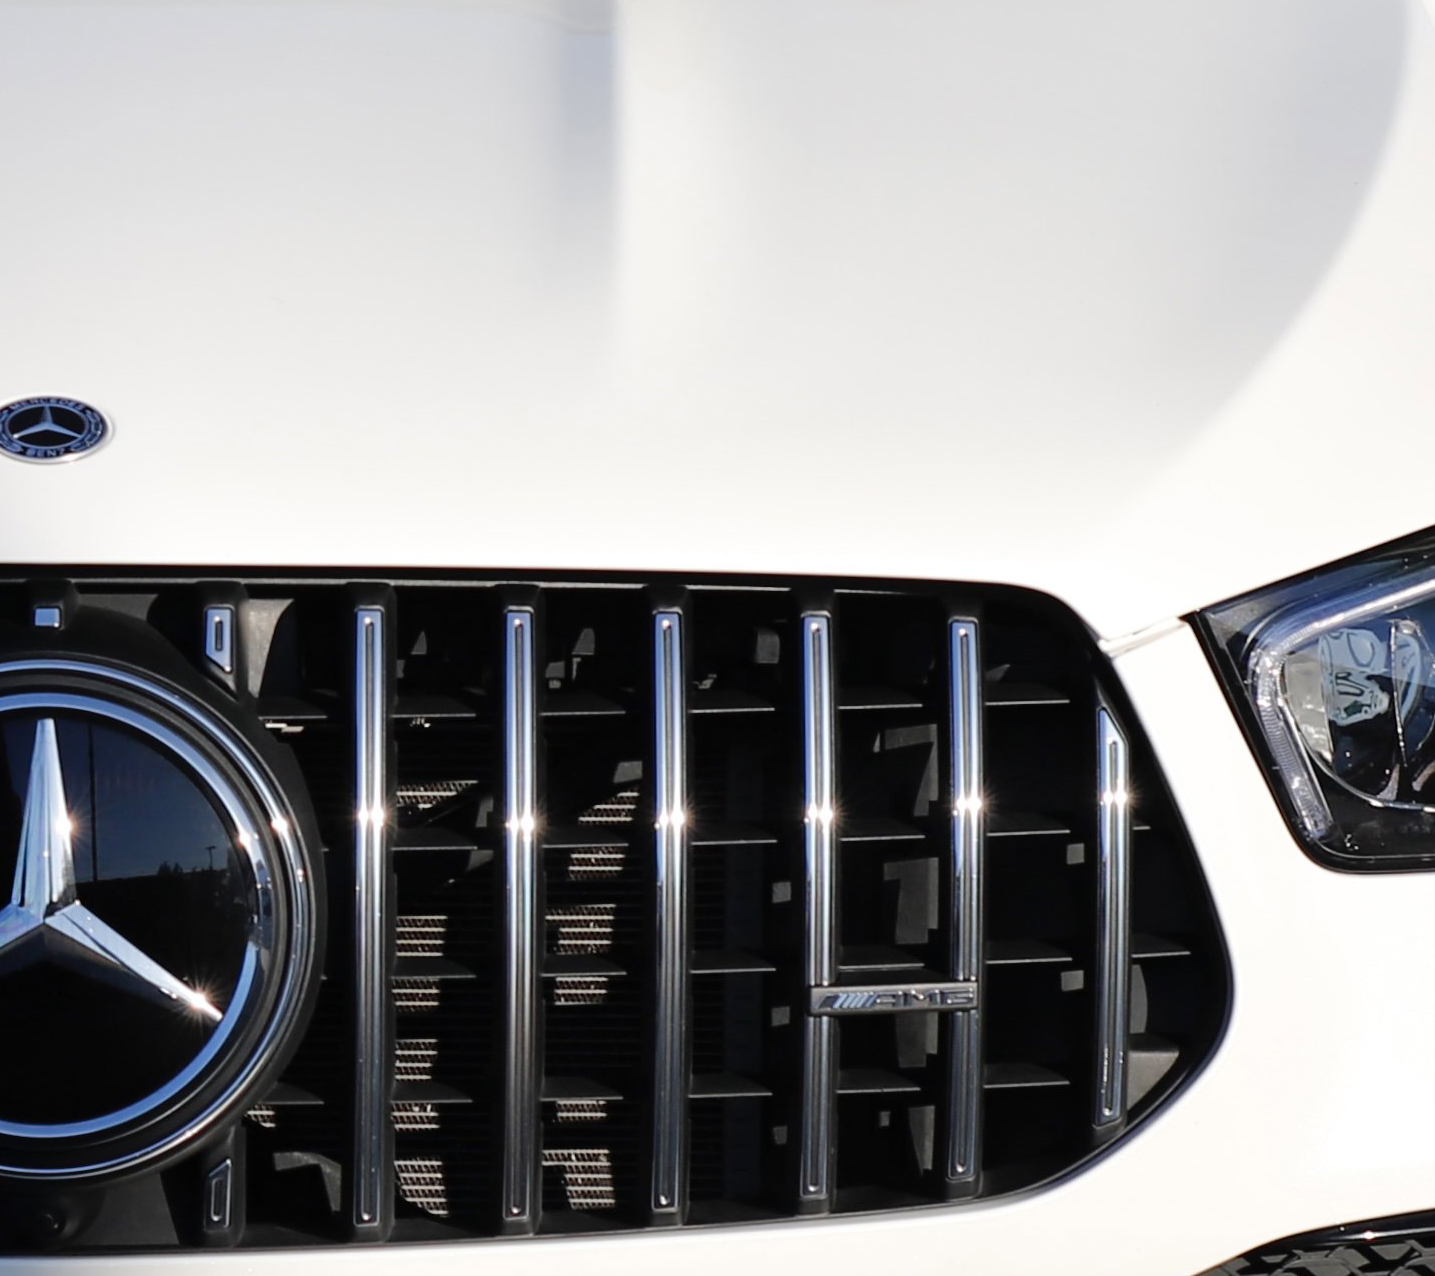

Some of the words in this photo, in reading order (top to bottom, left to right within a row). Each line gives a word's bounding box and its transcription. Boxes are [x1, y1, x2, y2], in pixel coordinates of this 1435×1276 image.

[8, 397, 87, 411] MERCEDES
[25, 447, 66, 458] BENZ
[871, 988, 975, 1009] AMG
